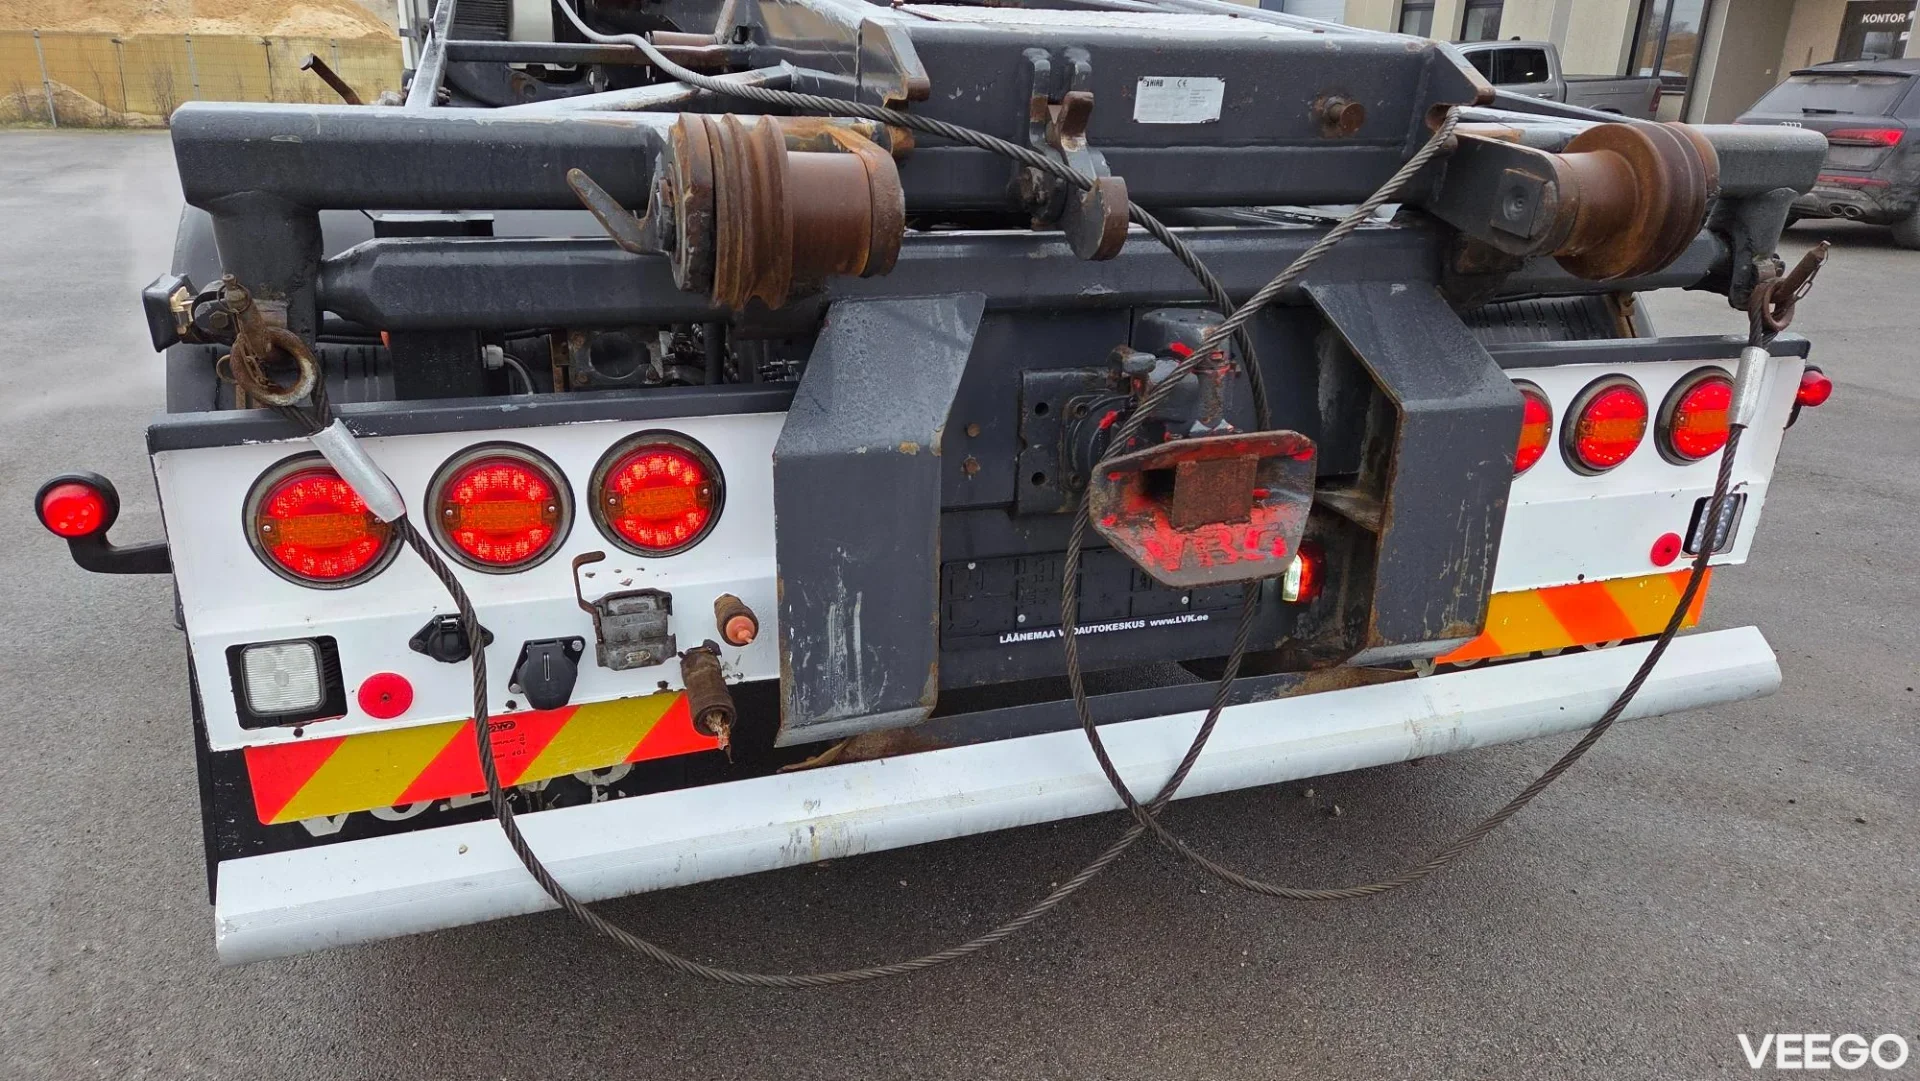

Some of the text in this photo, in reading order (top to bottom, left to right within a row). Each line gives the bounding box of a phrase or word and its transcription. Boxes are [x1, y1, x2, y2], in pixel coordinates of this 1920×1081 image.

[1862, 13, 1906, 24] KONTOR
[1000, 614, 1209, 644] LÄÄNEMAA VOAUTOKESKUS www.LVK.ee
